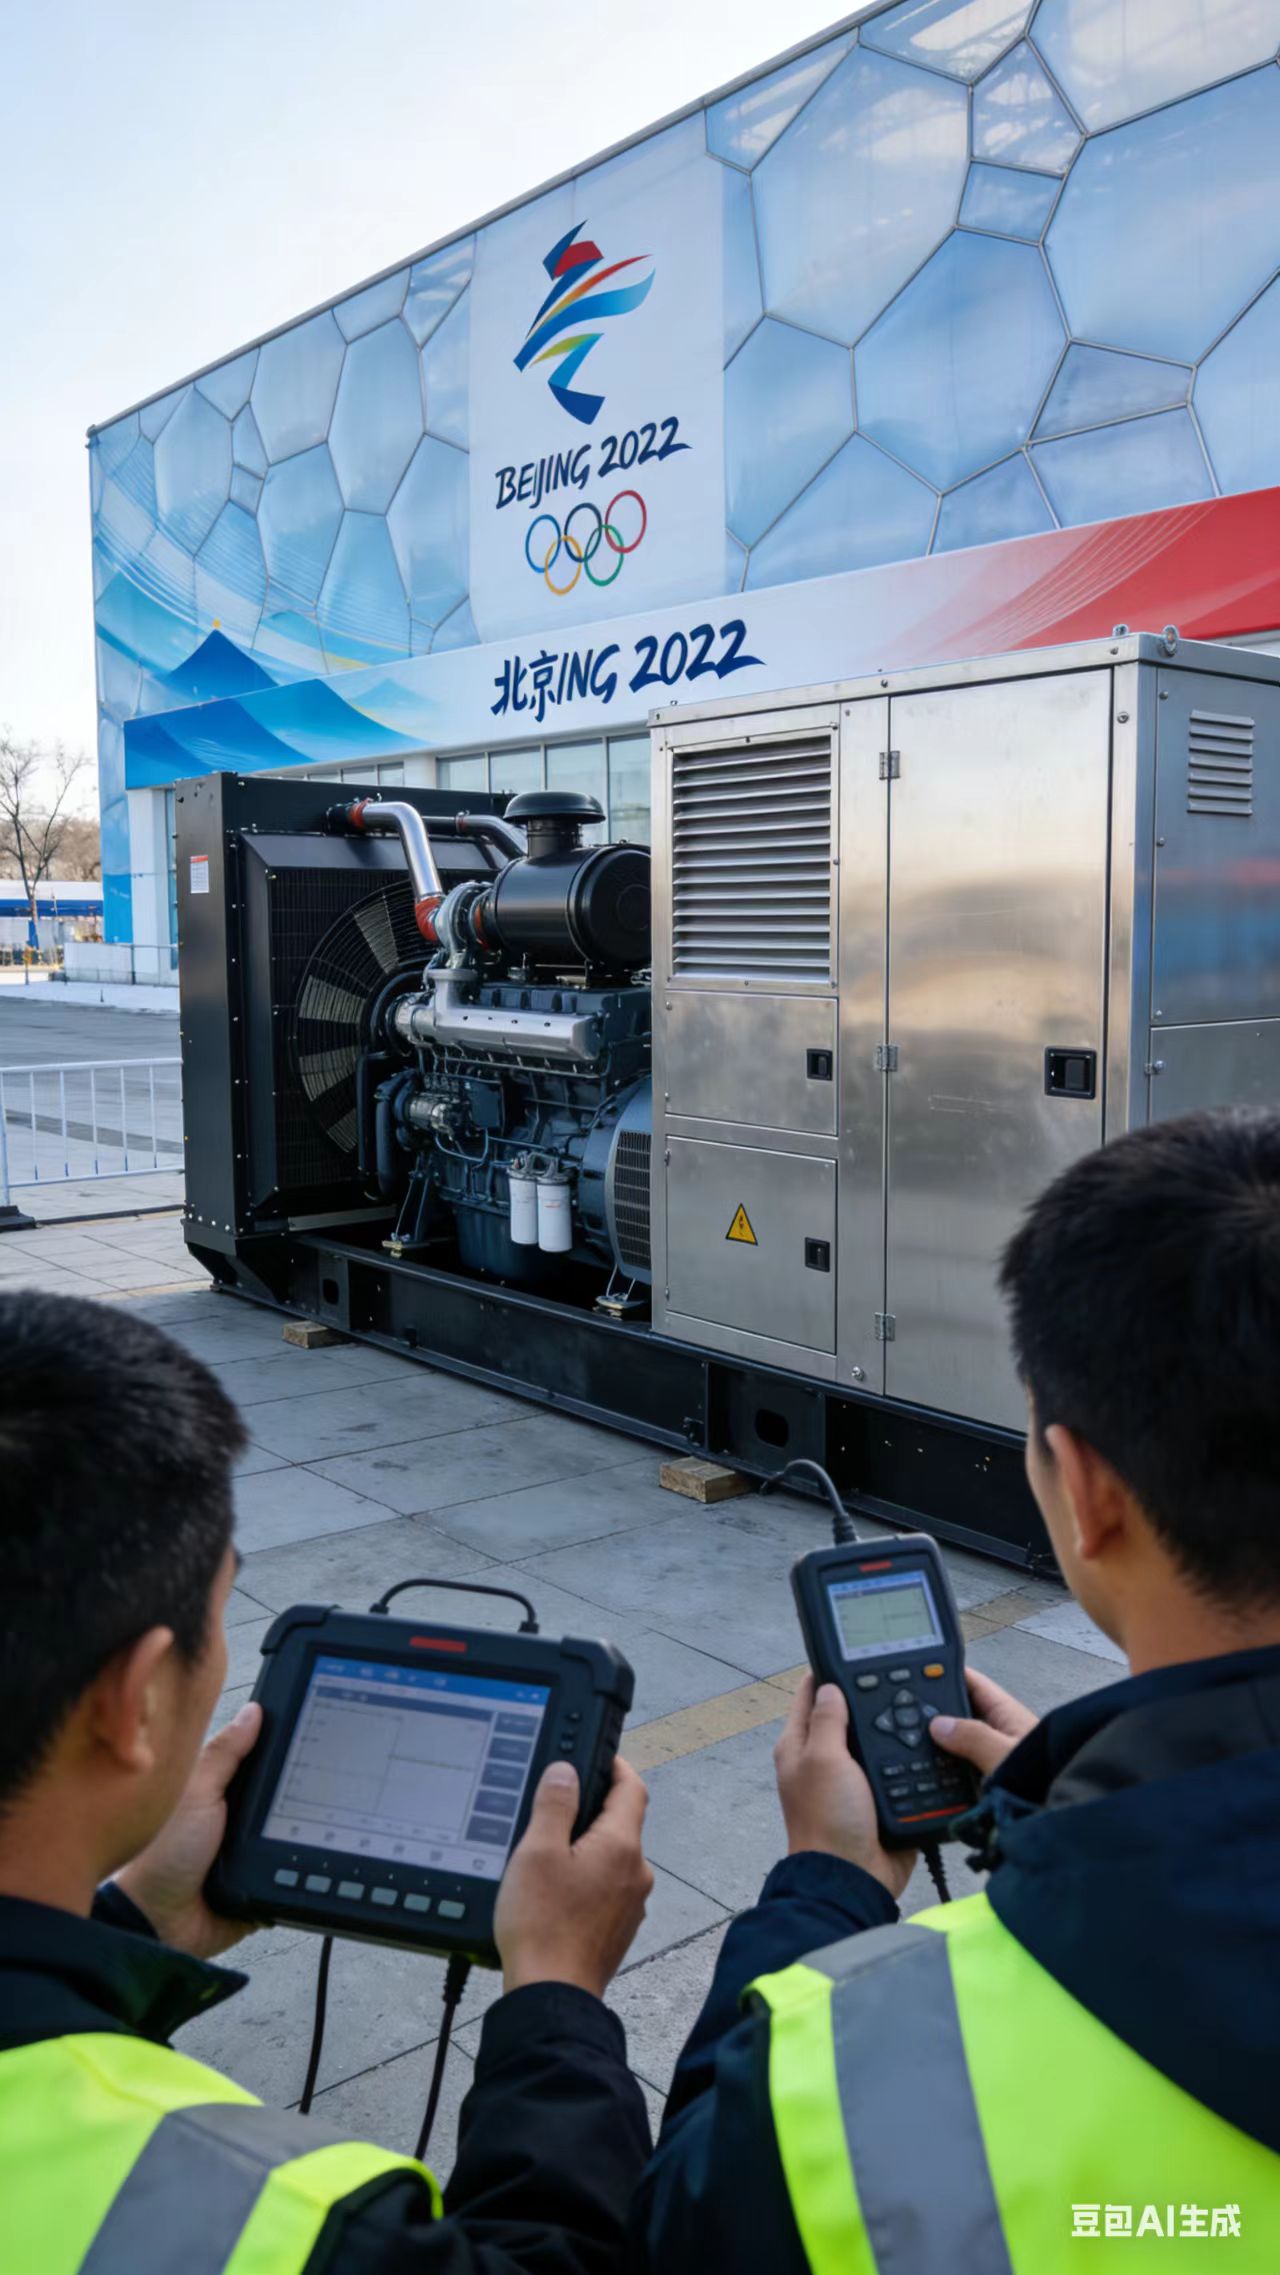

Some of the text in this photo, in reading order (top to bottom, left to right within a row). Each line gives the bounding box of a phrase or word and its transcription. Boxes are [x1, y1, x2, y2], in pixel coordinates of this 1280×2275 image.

[495, 416, 692, 510] BEIJING 2022
[629, 619, 767, 693] 2022
